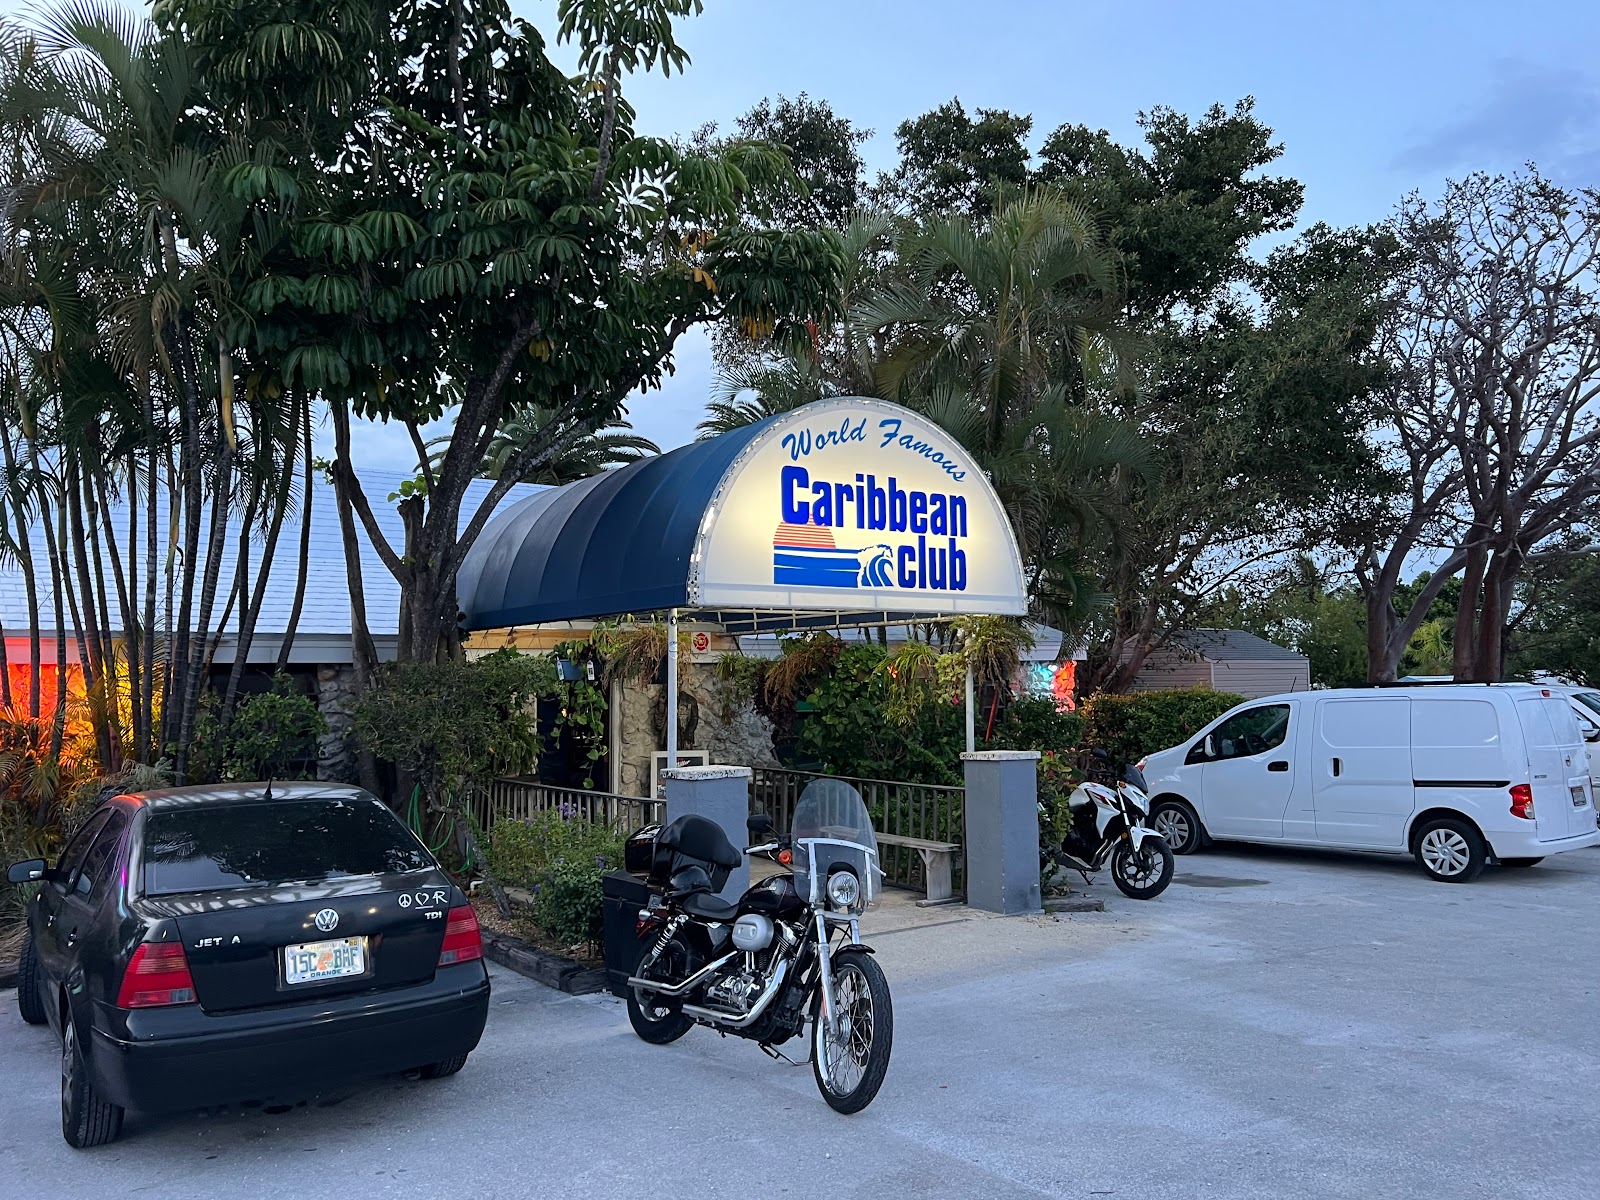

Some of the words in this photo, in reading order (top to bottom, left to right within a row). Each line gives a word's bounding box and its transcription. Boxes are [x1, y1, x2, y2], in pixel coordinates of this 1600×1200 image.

[781, 417, 867, 461] World
[878, 418, 966, 482] Famous
[780, 465, 968, 538] Caribbean
[897, 535, 967, 591] club
[424, 910, 442, 920] TDI
[310, 969, 342, 978] ORANGE
